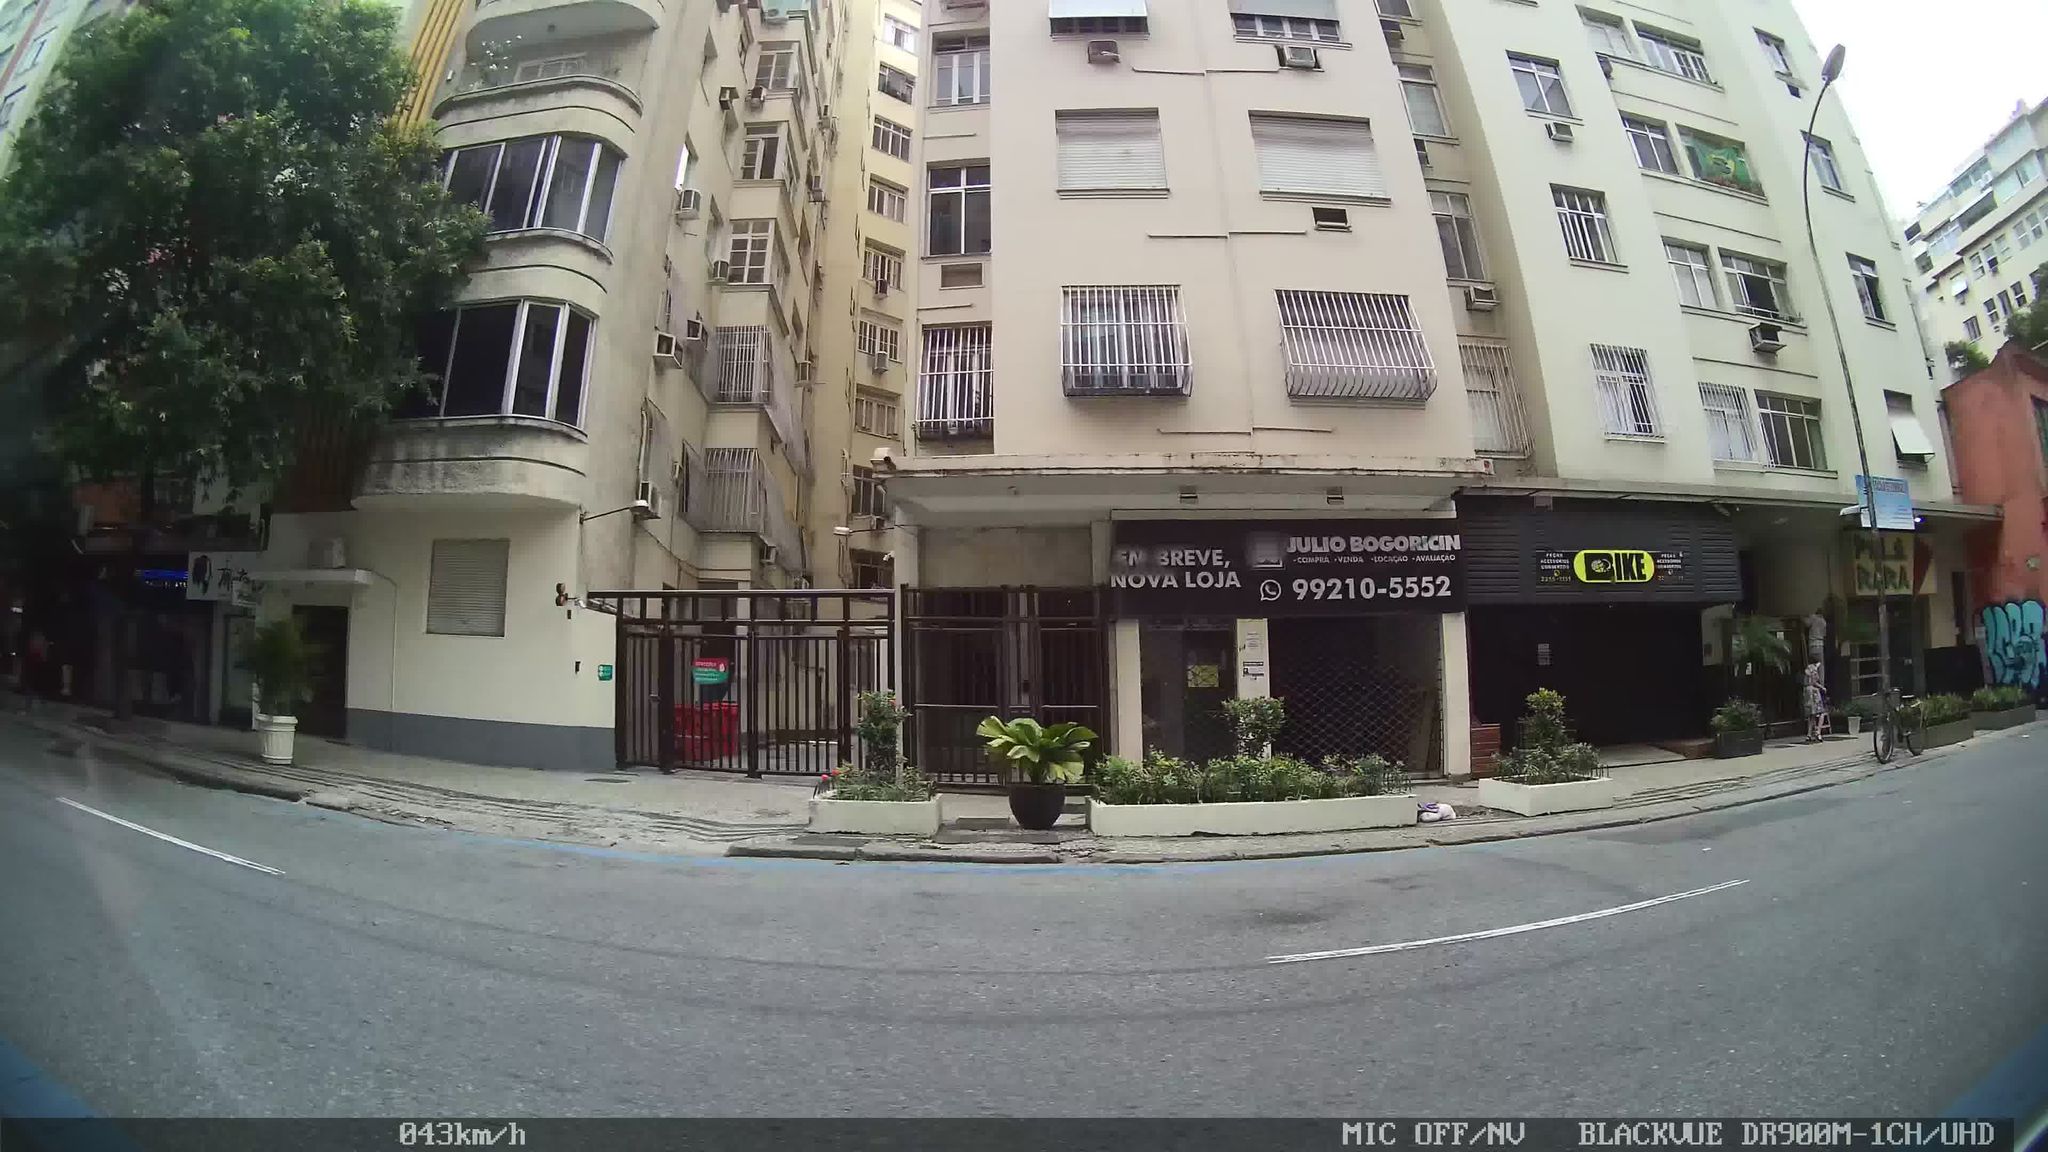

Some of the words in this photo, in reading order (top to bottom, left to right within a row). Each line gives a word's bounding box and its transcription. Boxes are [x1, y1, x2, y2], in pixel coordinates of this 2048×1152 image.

[1287, 536, 1345, 552] JULIO
[1350, 535, 1460, 551] BOGORICIN
[1110, 575, 1178, 588] NOVA
[1186, 571, 1241, 588] LOJA
[1292, 576, 1452, 600] 99210-5552
